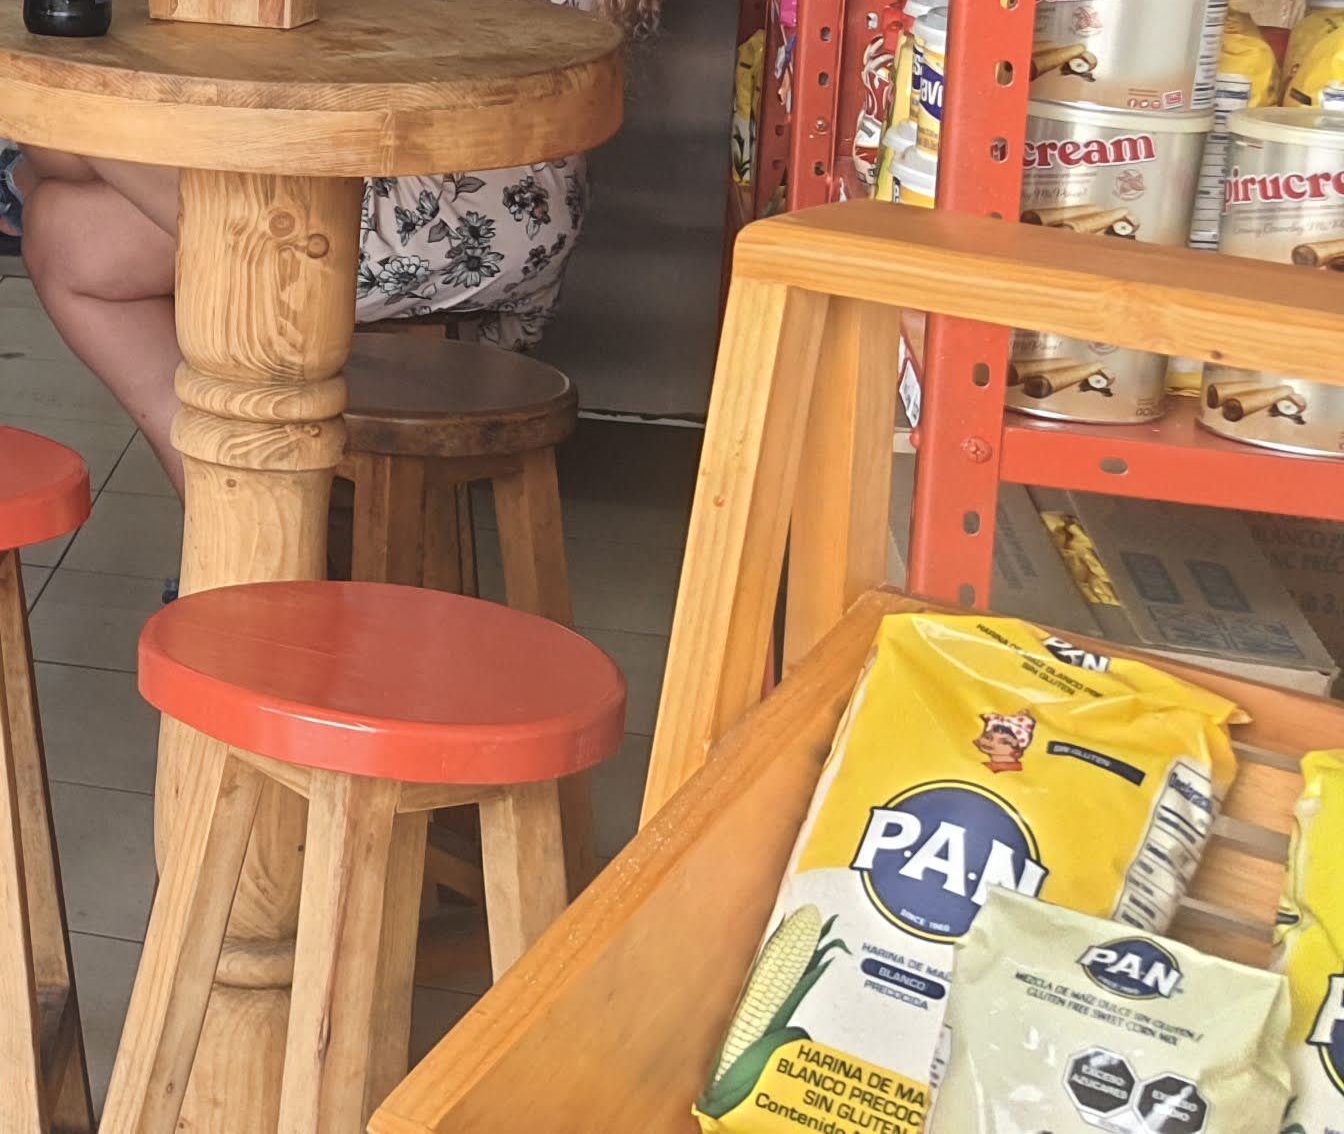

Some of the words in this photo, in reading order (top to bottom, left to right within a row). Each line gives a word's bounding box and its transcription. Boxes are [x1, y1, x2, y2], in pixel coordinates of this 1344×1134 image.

[862, 943, 906, 966] HARINA
[908, 959, 924, 971] DE
[863, 979, 929, 1011] PRECOCIDA
[878, 967, 927, 991] BLANCO
[776, 1057, 847, 1097] BLANCO
[797, 1044, 863, 1083] HARINA
[866, 1072, 894, 1095] DE
[802, 1089, 834, 1114] SIN
[836, 1102, 908, 1134] GLUTEN
